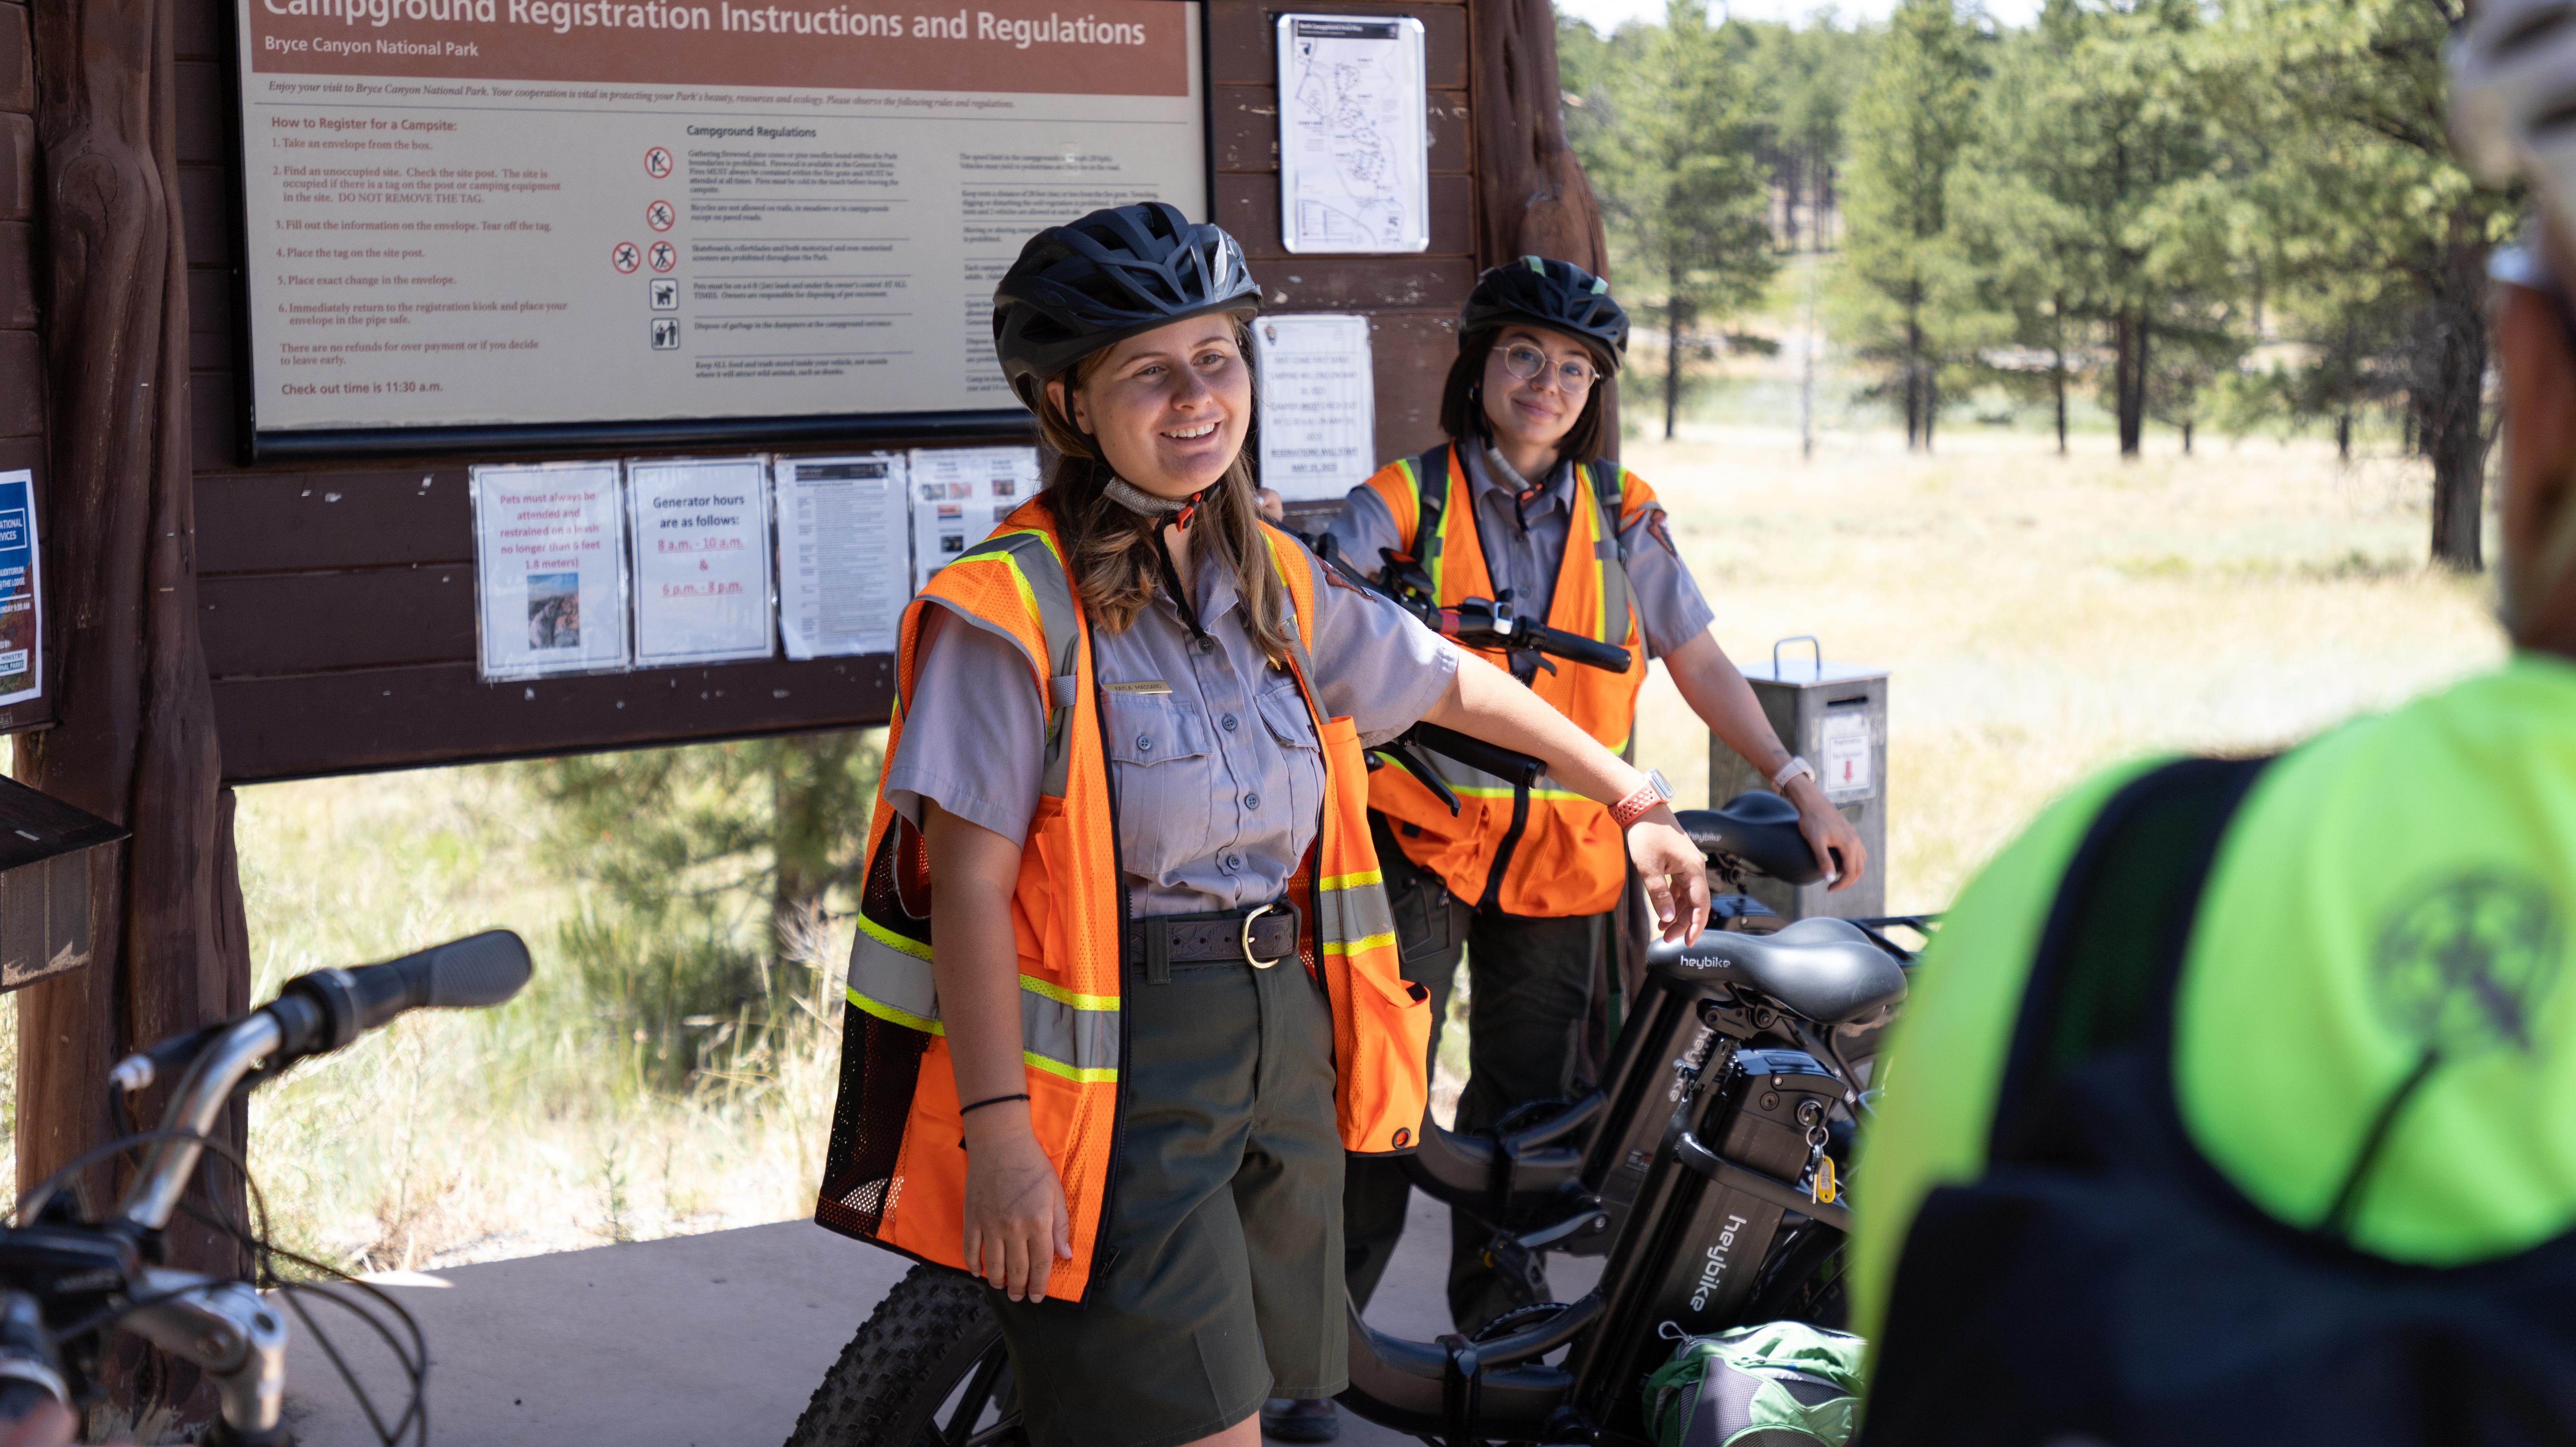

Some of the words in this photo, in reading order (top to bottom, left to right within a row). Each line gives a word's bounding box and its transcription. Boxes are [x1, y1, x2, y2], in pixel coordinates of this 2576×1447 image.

[264, 0, 495, 27] Campground
[509, 0, 710, 34] Registration
[721, 1, 903, 38] Instructions
[912, 9, 968, 40] and
[978, 11, 1146, 50] Regulations
[265, 36, 308, 54] Bryce
[313, 38, 372, 57] Canyon
[376, 40, 441, 55] National
[445, 42, 479, 57] Park
[272, 117, 300, 128] How
[303, 118, 316, 129] to
[319, 119, 367, 132] Register
[370, 119, 387, 130] for
[391, 121, 398, 130] a
[401, 119, 457, 134] Campsite:
[687, 125, 754, 138] Campground
[757, 126, 817, 139] Regulations
[272, 138, 280, 148] 1.
[283, 138, 305, 148] Take
[322, 139, 366, 152] envelope
[368, 140, 392, 149] from
[394, 140, 410, 150] the
[411, 140, 433, 150] box.
[272, 167, 281, 176] 2.
[283, 167, 307, 176] Find
[323, 167, 381, 179] unoccupied
[382, 168, 402, 177] site.
[406, 168, 437, 178] Check
[439, 168, 455, 178] the
[457, 168, 473, 178] site
[475, 168, 497, 180] post.
[502, 169, 520, 178] The
[522, 169, 538, 178] site
[540, 169, 548, 178] is
[283, 179, 328, 191] occupied
[330, 180, 338, 189] if
[339, 180, 365, 189] there
[367, 180, 376, 189] is
[385, 180, 400, 192] tag
[416, 180, 432, 190] the
[434, 180, 455, 192] post
[469, 181, 510, 193] camping
[511, 181, 561, 194] equipment
[283, 193, 294, 202] in
[296, 193, 311, 202] the
[313, 193, 333, 202] site.
[338, 194, 356, 203] DO
[358, 194, 382, 203] NOT
[385, 194, 433, 203] REMOVE
[435, 194, 457, 203] THE
[460, 194, 484, 203] TAG.
[275, 221, 283, 230] 3.
[286, 221, 302, 230] Fill
[304, 221, 321, 230] out
[323, 221, 339, 230] the
[341, 221, 400, 230] information
[416, 221, 432, 230] the
[433, 221, 478, 233] envelope.
[481, 221, 502, 230] Tear
[504, 221, 518, 230] off
[519, 221, 534, 230] the
[535, 221, 552, 233] tag.
[276, 248, 284, 258] 4.
[286, 248, 314, 258] Place
[315, 248, 331, 258] the
[334, 249, 349, 261] tag
[365, 249, 381, 258] the
[383, 249, 400, 258] site
[402, 249, 425, 260] post.
[277, 276, 286, 285] 5.
[288, 276, 315, 285] Place
[317, 276, 343, 285] exact
[345, 275, 379, 287] change
[381, 275, 392, 285] in
[393, 275, 409, 285] the
[411, 275, 456, 287] envelope.
[278, 304, 287, 313] 6.
[289, 303, 350, 315] Immediately
[353, 303, 384, 312] return
[386, 303, 396, 312] to
[398, 303, 413, 312] the
[416, 302, 471, 314] registration
[473, 302, 498, 311] kiosk
[500, 302, 519, 311] and
[519, 302, 544, 313] place
[546, 304, 568, 313] your
[282, 384, 316, 395] Check
[320, 383, 340, 394] out
[343, 383, 369, 394] time
[373, 383, 382, 394] is
[387, 382, 416, 393] 11:30
[419, 384, 443, 393] a.m.
[500, 494, 521, 504] Pets
[523, 493, 547, 503] must
[549, 492, 581, 505] always
[584, 491, 597, 501] be
[653, 495, 710, 508] Generator
[713, 494, 744, 507] hours
[517, 509, 560, 520] attended
[563, 508, 580, 519] and
[660, 519, 678, 529] are
[681, 519, 693, 528] as
[696, 515, 739, 527] follows:
[500, 526, 549, 537] restrained
[574, 524, 599, 534] leash
[515, 543, 546, 556] longer
[549, 542, 570, 552] than
[581, 541, 601, 550] feet
[658, 538, 665, 551] 8
[668, 540, 692, 550] a.m.
[704, 537, 717, 549] 10
[719, 539, 744, 549] a.m.
[699, 560, 709, 571] &
[12, 577, 25, 587] LODGE
[663, 583, 669, 595] 6
[672, 584, 696, 597] p.m.
[708, 581, 715, 593] 8
[717, 582, 743, 595] p.m.
[23, 601, 31, 610] AM
[1, 652, 23, 662] MINISTRY
[9, 661, 23, 670] PARKS
[1689, 830, 1722, 843] heybike
[1680, 955, 1731, 970] heybike
[1690, 1215, 1747, 1312] heybike
